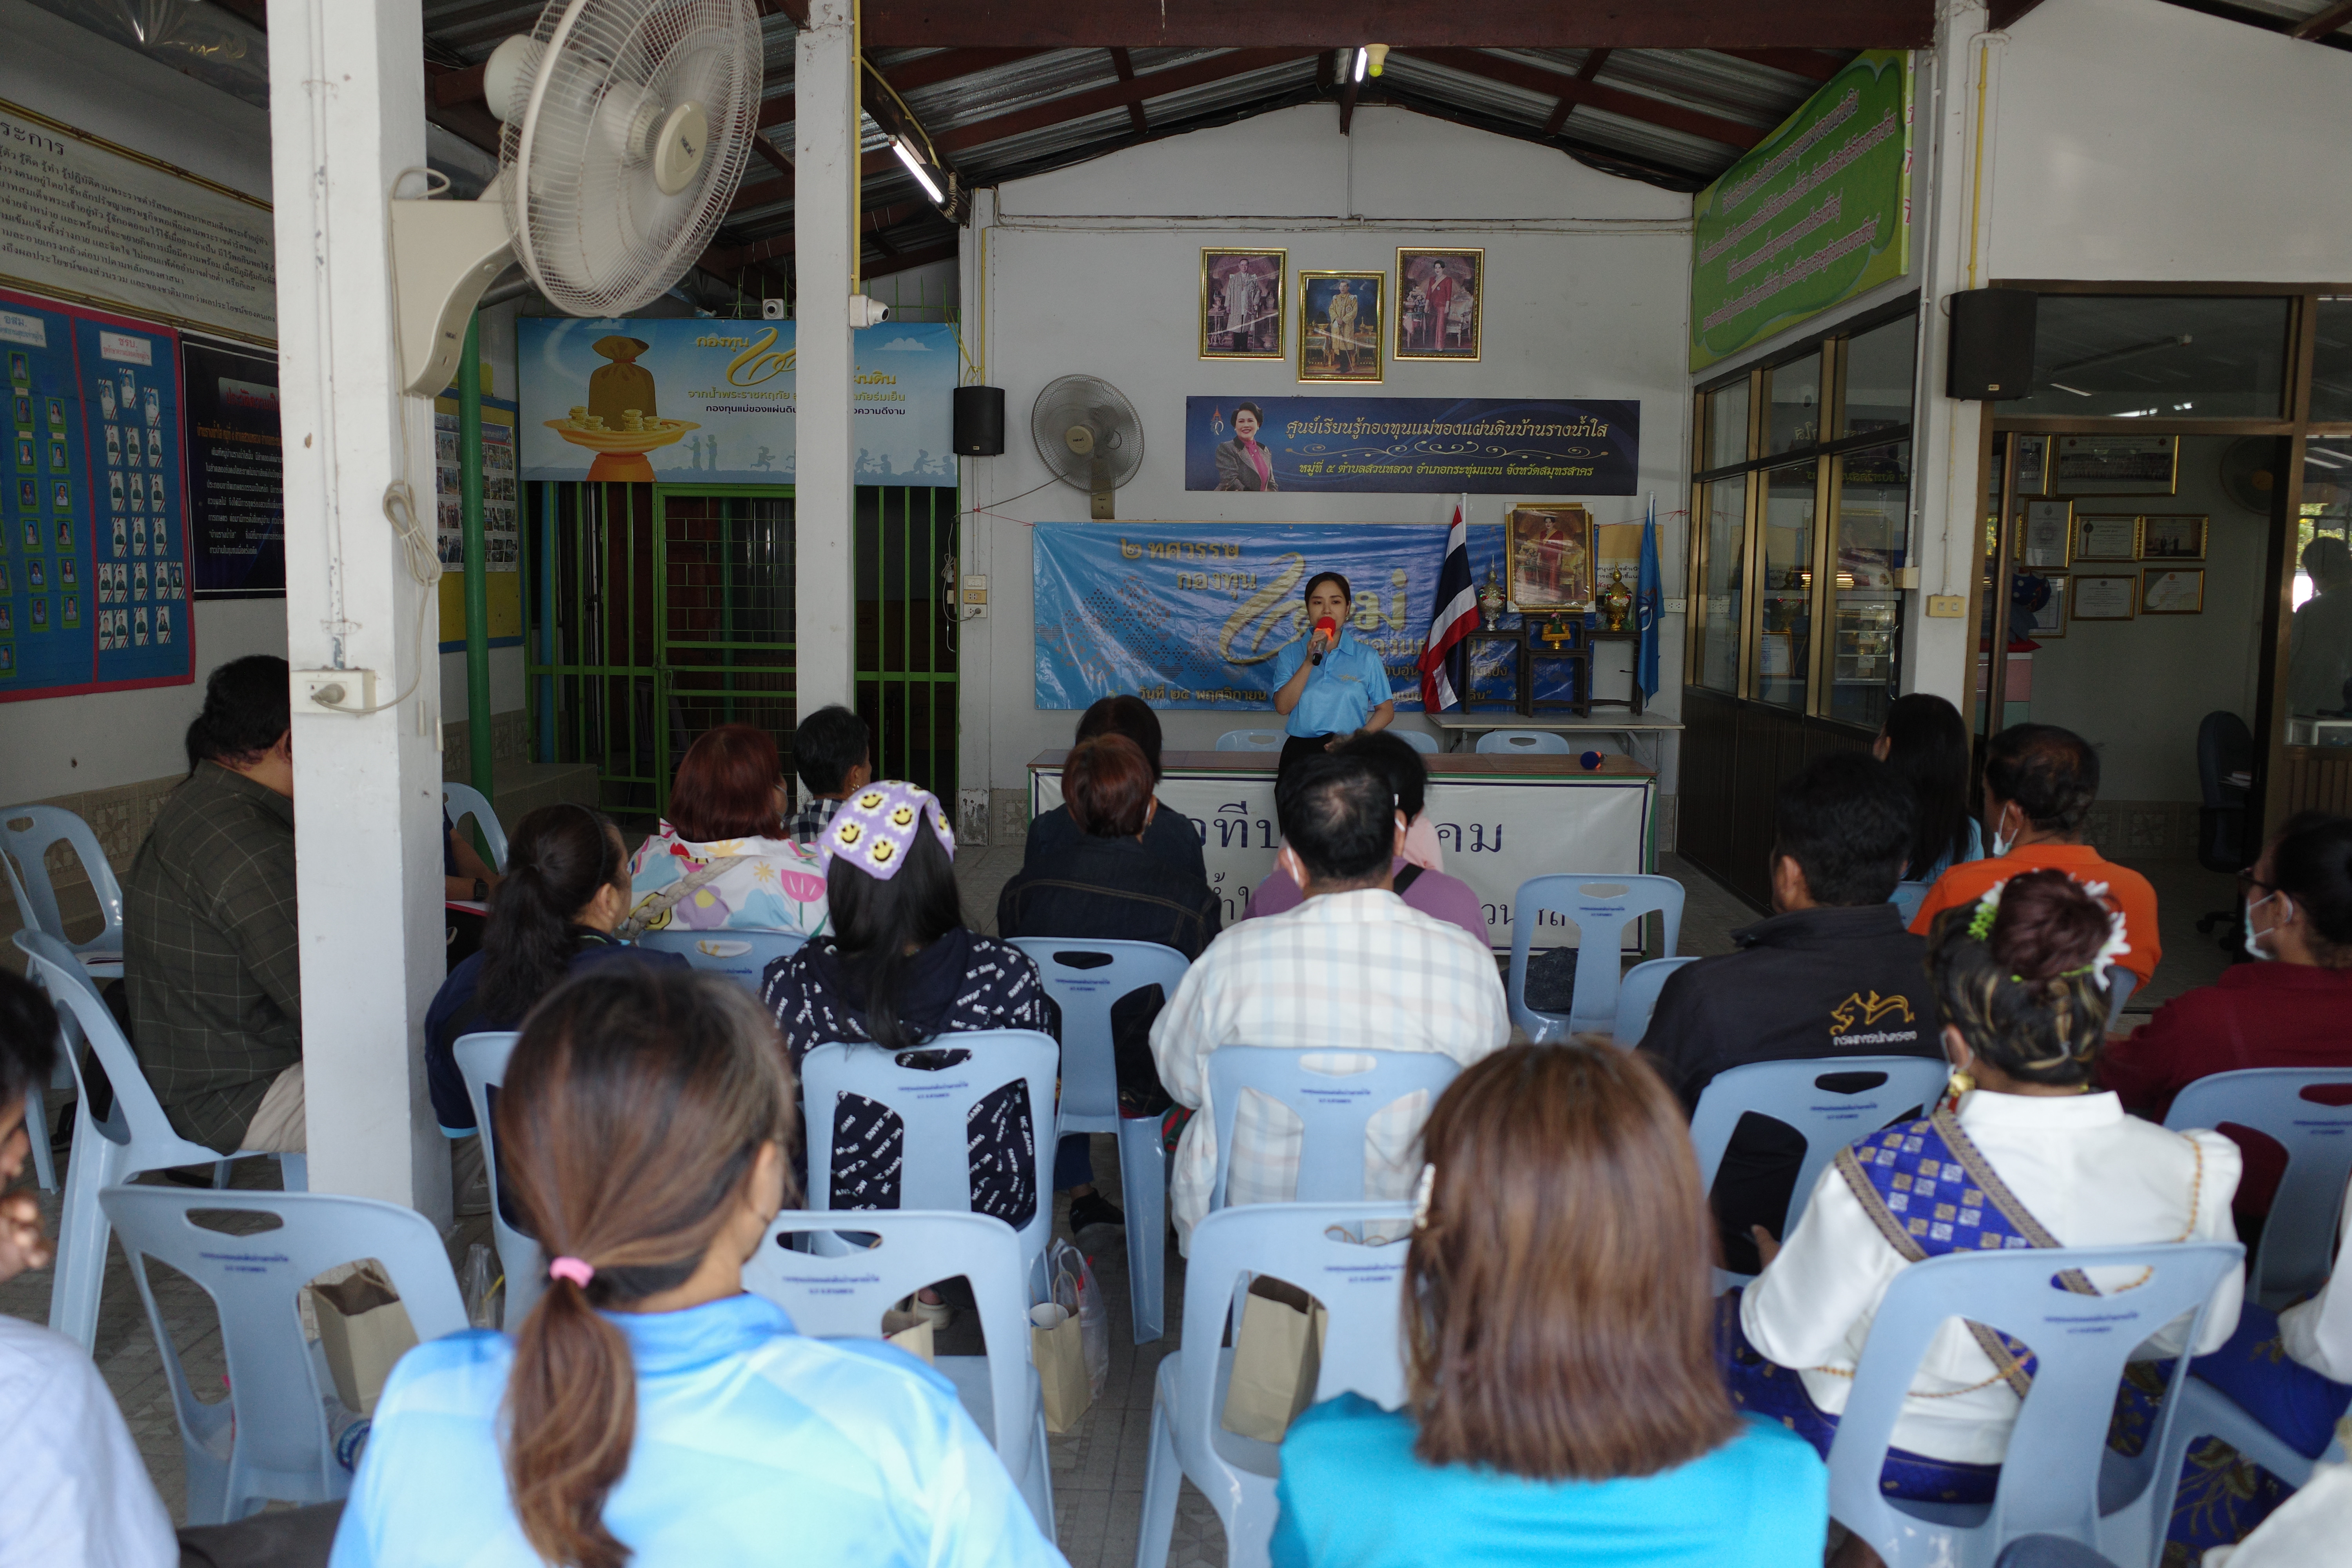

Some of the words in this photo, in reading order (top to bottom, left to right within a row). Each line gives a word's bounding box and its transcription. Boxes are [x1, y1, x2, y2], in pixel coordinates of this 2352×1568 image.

[0, 121, 65, 156] ระการ
[19, 151, 38, 170] รู้คิด
[42, 159, 58, 177] รู้ทำ
[62, 166, 267, 247] รู้ปฏิบัติตามพระราชดำรัสของพระบาทสมเด็จพระเจ้าอยู่หัว
[118, 337, 137, 348] ชรบ.
[695, 336, 750, 352] กองทุน
[688, 387, 790, 401] จากน้ำพระราชหฤทัย
[1286, 415, 1608, 440] ศูนย์เรียนรู้กองทุนแม่ของแผ่นดินบ้านรางน้ำใส
[1299, 459, 1323, 478] หมู่ที่
[1338, 461, 1412, 475] ตำบลสวนหลวง
[1416, 463, 1503, 477] อำเภอกระทุ่มแบน
[1506, 463, 1594, 478] จังหวัดสมุทรสาคร
[1120, 538, 1142, 559] ๒
[1148, 542, 1240, 560] ทศวรรษ
[1177, 572, 1257, 601] กองทุน
[1139, 683, 1165, 700] วันที่
[1195, 685, 1267, 703] พฤศจิกายน
